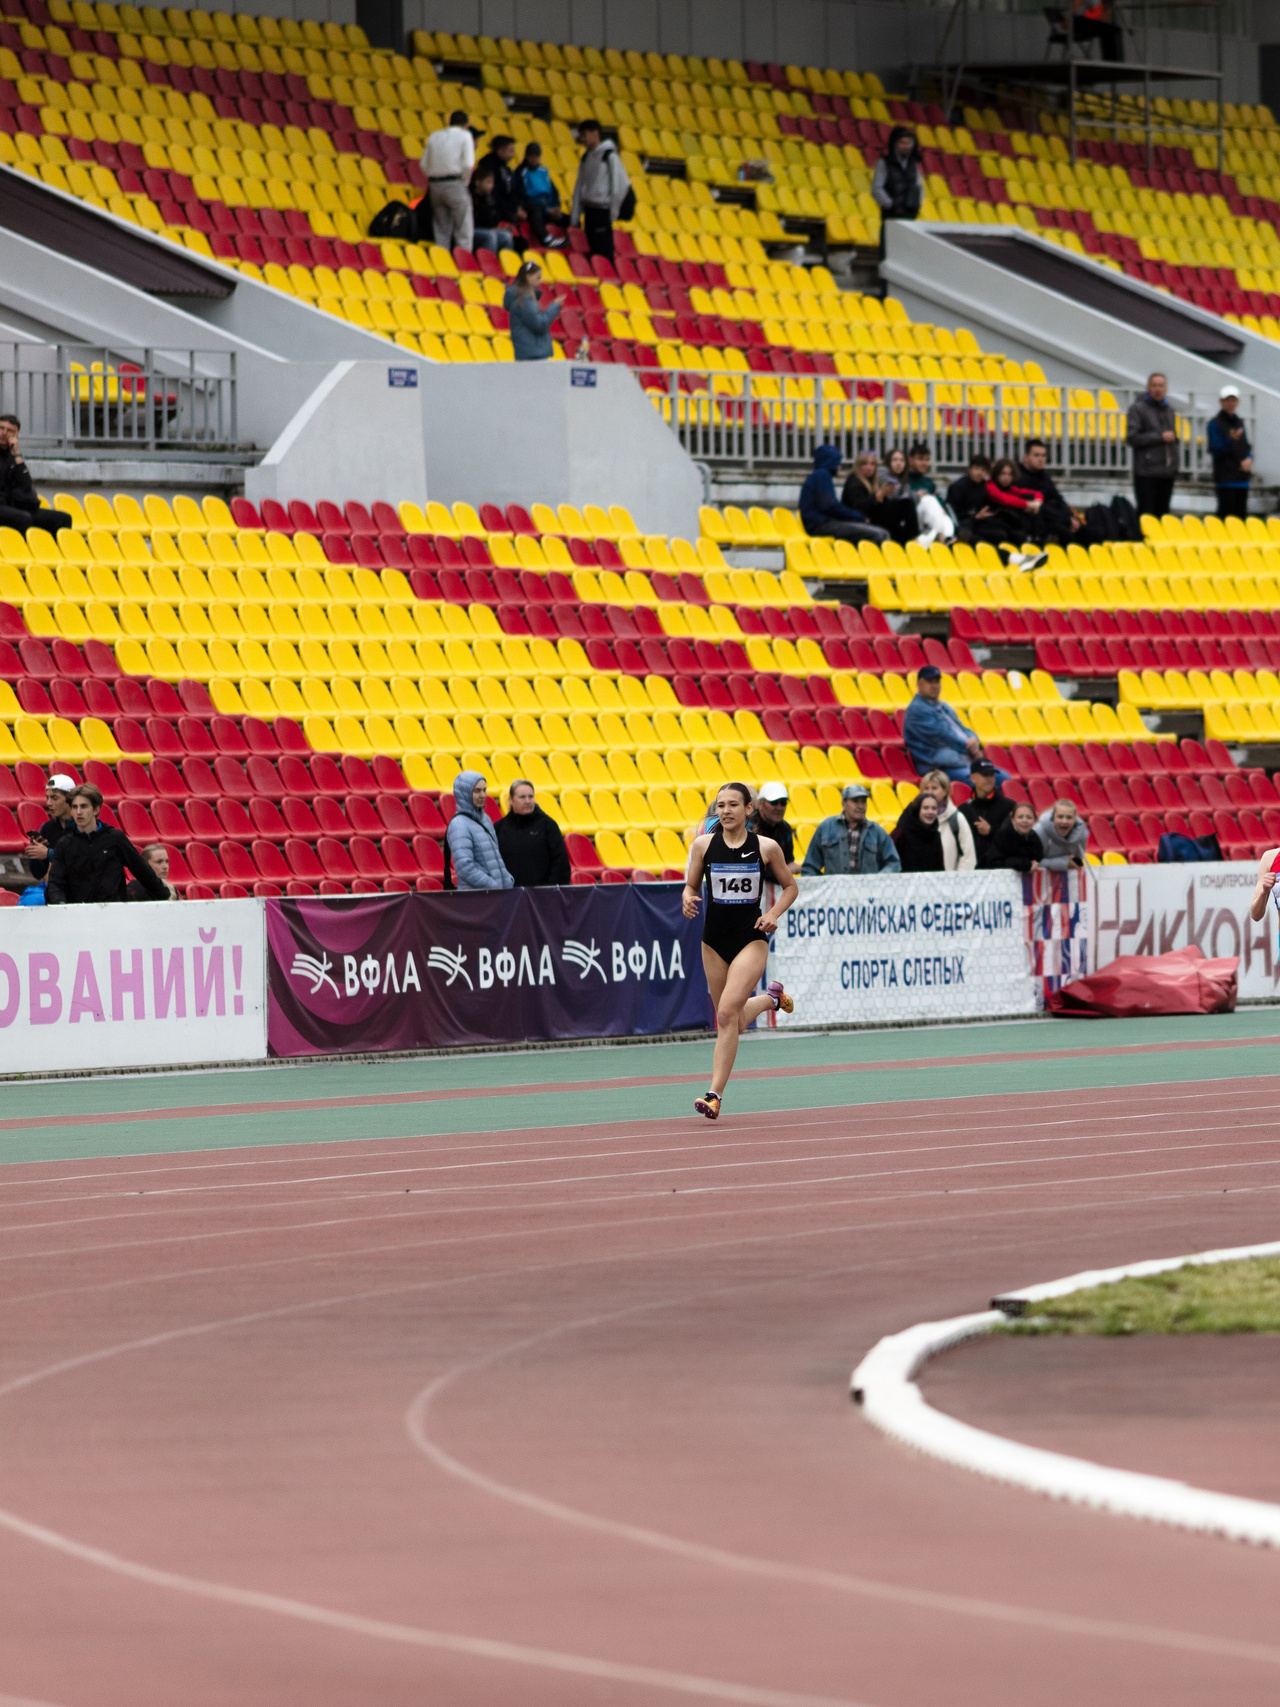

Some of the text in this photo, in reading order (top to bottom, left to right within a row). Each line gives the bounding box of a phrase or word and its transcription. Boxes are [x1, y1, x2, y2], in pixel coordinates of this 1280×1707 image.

[719, 878, 752, 893] 148
[787, 898, 1013, 938] ВСЕРОССИЙСКАЯ ФЕДЕРАЦИЯ
[0, 927, 244, 1028] ОВАНИЙ!
[343, 939, 686, 997] ВФЛА ВФЛА ВФЛА
[841, 955, 965, 989] СПОРТА СЛЕПЫХ
